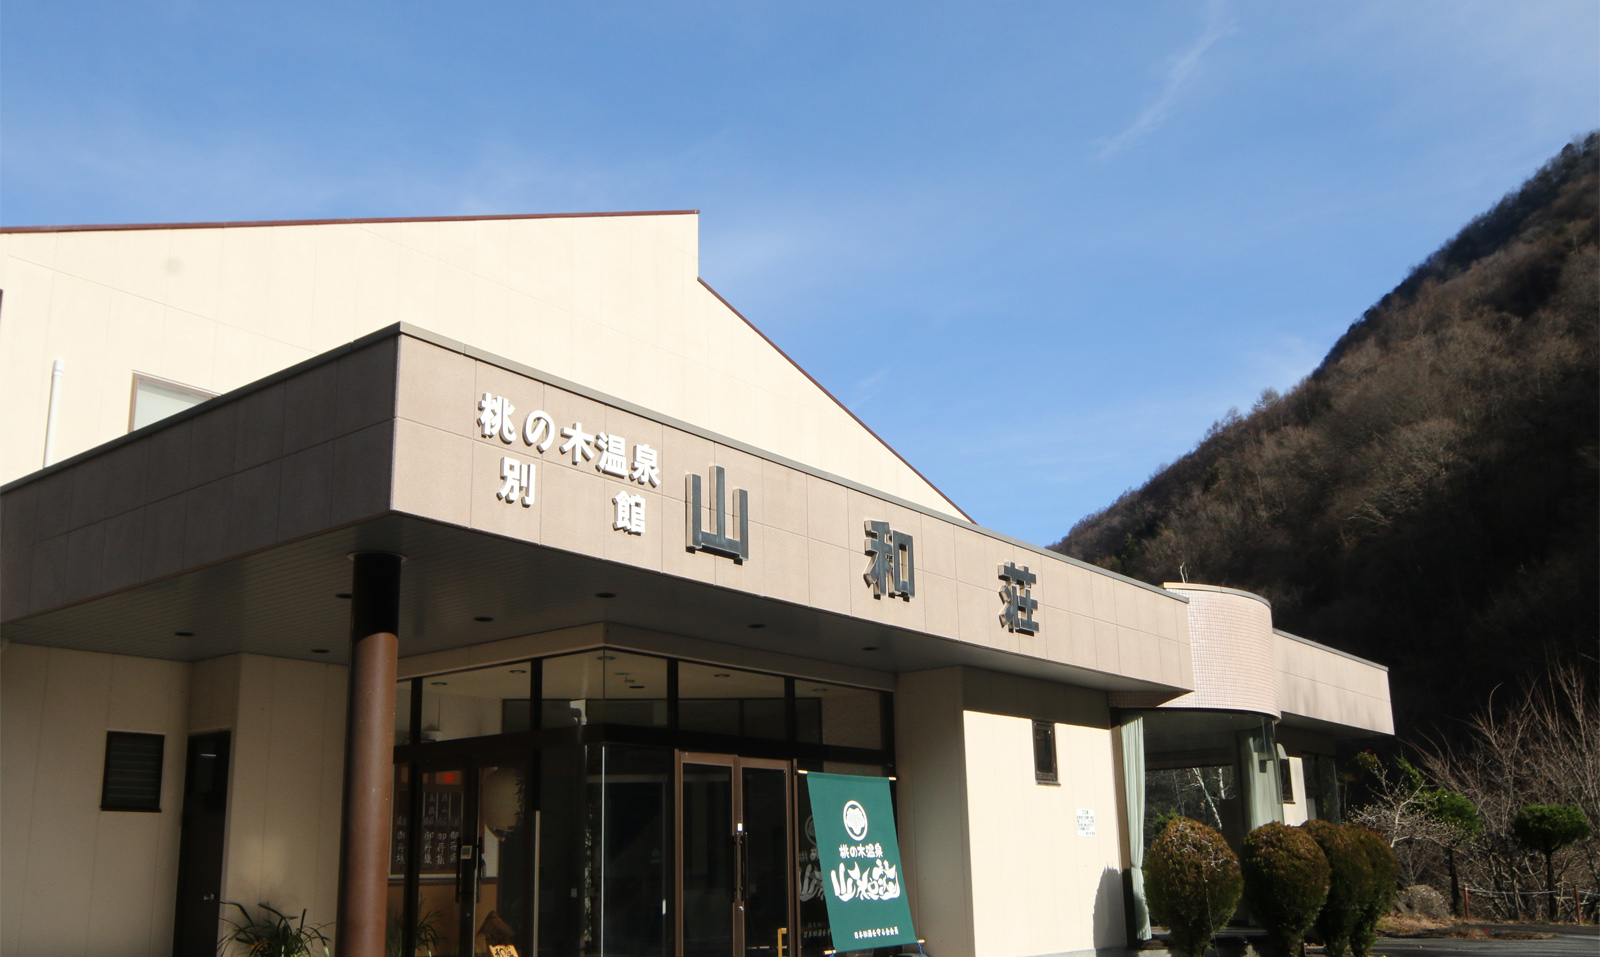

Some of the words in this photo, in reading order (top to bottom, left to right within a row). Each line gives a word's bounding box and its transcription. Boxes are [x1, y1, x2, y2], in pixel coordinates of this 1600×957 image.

[477, 392, 660, 488] 桃の木温泉
[497, 455, 647, 535] 別館
[685, 464, 1040, 637] 山和荘
[838, 842, 884, 859] 桃の木温泉
